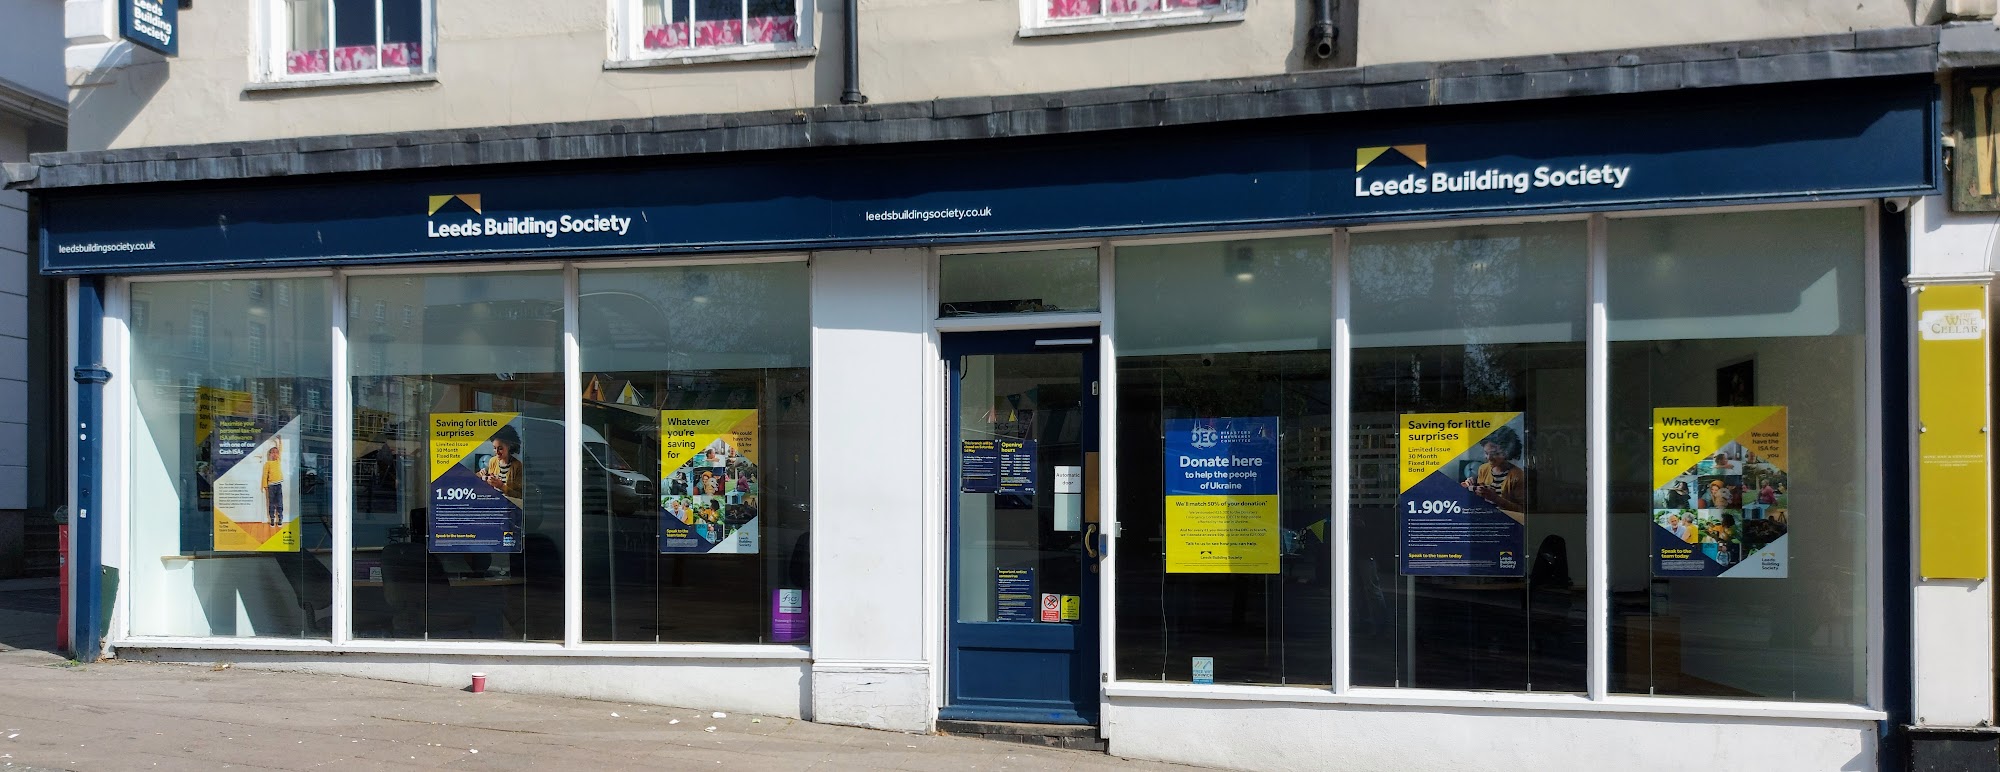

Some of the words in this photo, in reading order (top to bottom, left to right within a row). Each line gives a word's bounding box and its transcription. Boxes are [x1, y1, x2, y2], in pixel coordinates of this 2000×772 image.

[134, 6, 171, 35] Building
[134, 18, 170, 45] Society
[1355, 174, 1427, 197] Leeds
[1431, 170, 1529, 193] Building
[1533, 164, 1630, 188] Society
[866, 206, 992, 221] leedsbuildingsociety.co.uk
[428, 218, 482, 238] Leeds
[484, 216, 558, 238] Building
[560, 214, 631, 235] Society
[58, 241, 156, 253] leedsbuildingsociety.co.uk
[1944, 315, 1977, 326] WINE
[1931, 323, 1978, 334] CELLAR
[436, 419, 464, 428] Saving
[465, 419, 477, 427] for
[478, 419, 498, 427] little
[667, 418, 710, 426] Whatever
[1408, 420, 1445, 431] Saving
[1447, 420, 1463, 429] for
[1465, 420, 1491, 428] little
[1662, 417, 1720, 426] Whatever
[436, 430, 475, 438] surprises
[667, 429, 695, 438] you're
[1408, 432, 1459, 442] surprises
[1662, 430, 1699, 441] you're
[667, 440, 696, 449] saving
[1662, 443, 1701, 454] saving
[1179, 455, 1230, 468] Donate
[1231, 455, 1263, 467] here
[1662, 456, 1679, 465] for
[1195, 470, 1213, 480] help
[1214, 470, 1228, 478] the
[1229, 470, 1257, 480] people
[1210, 482, 1242, 490] Ukraine
[436, 488, 477, 500] 1.90%
[1407, 500, 1461, 514] 1.90%
